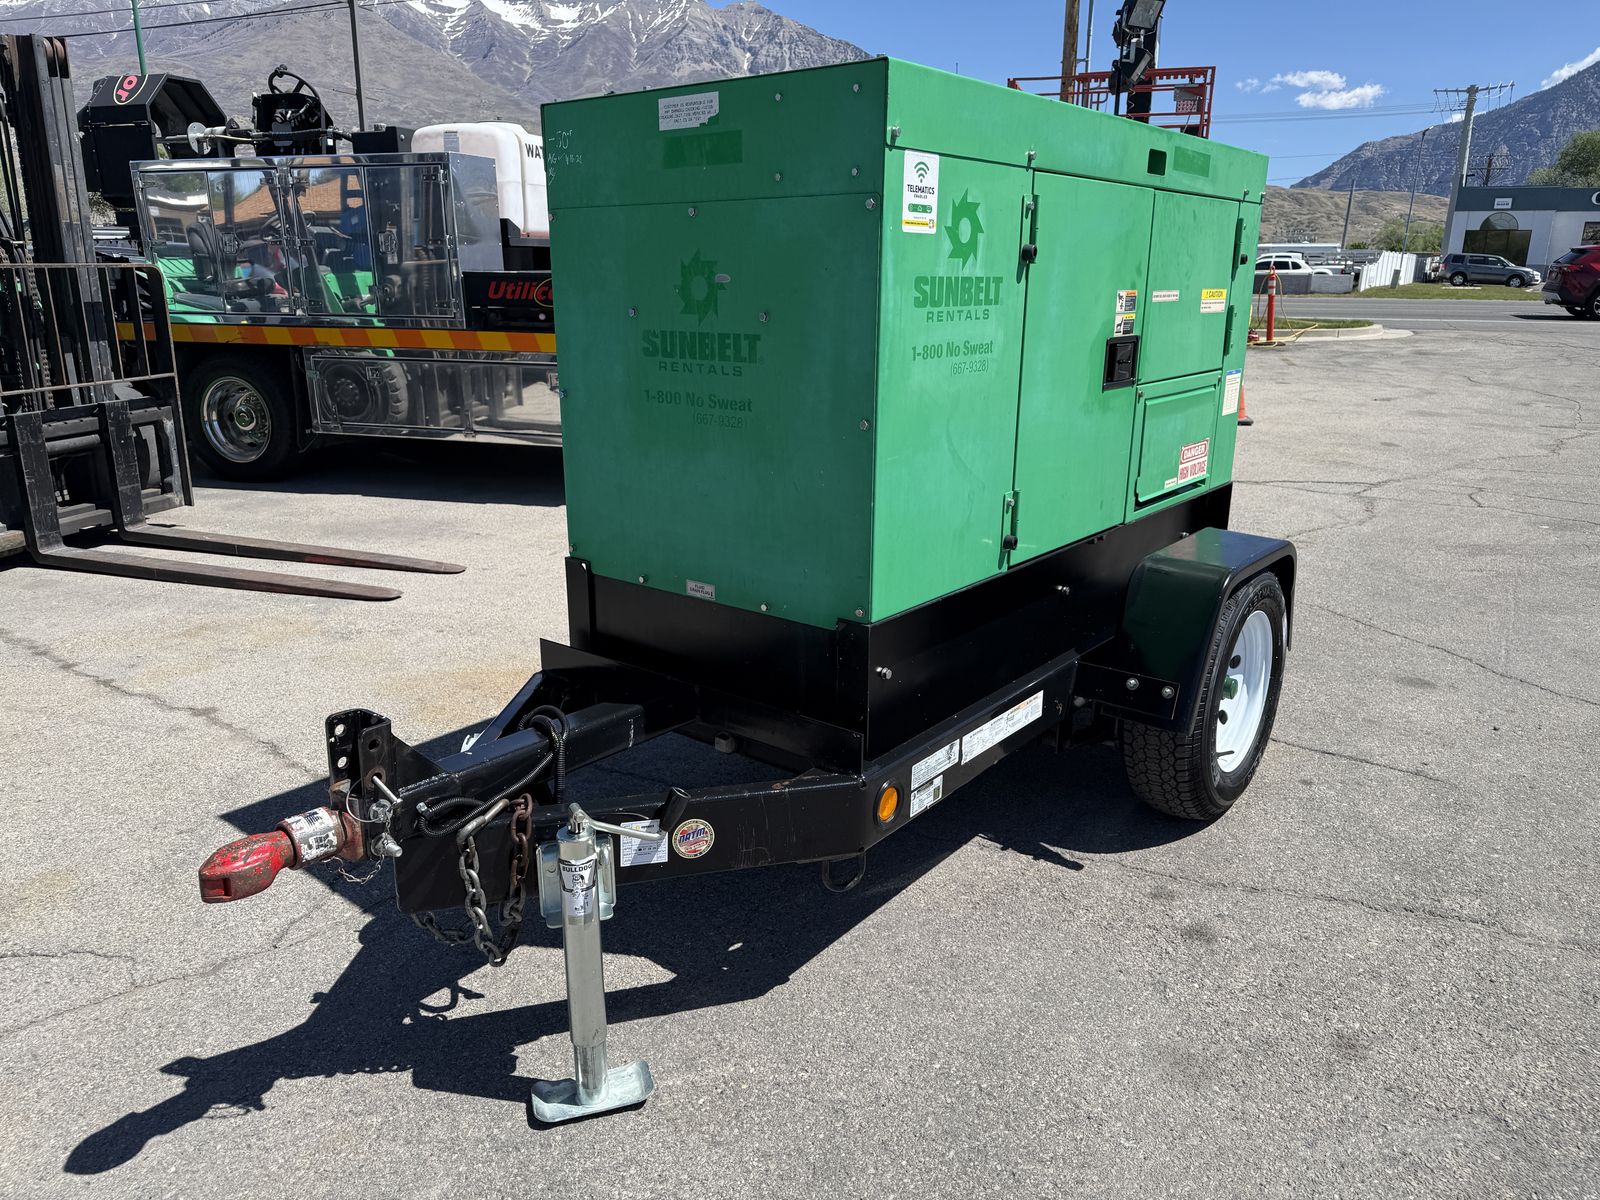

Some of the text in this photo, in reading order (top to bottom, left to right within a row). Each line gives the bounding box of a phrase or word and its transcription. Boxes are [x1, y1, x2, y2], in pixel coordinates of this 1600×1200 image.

[907, 184, 934, 195] TELEMATICS
[914, 276, 1004, 308] SUNBELT
[926, 309, 990, 323] RENTALS
[642, 329, 760, 363] SUNBELT
[912, 340, 993, 361] 1-800 No Sweat
[659, 361, 743, 377] RENTALS
[951, 358, 989, 376] (667-9328)
[644, 390, 752, 412] 1-800 No Sweat
[1184, 445, 1206, 459] DANGER
[562, 864, 593, 872] BULLDOG
